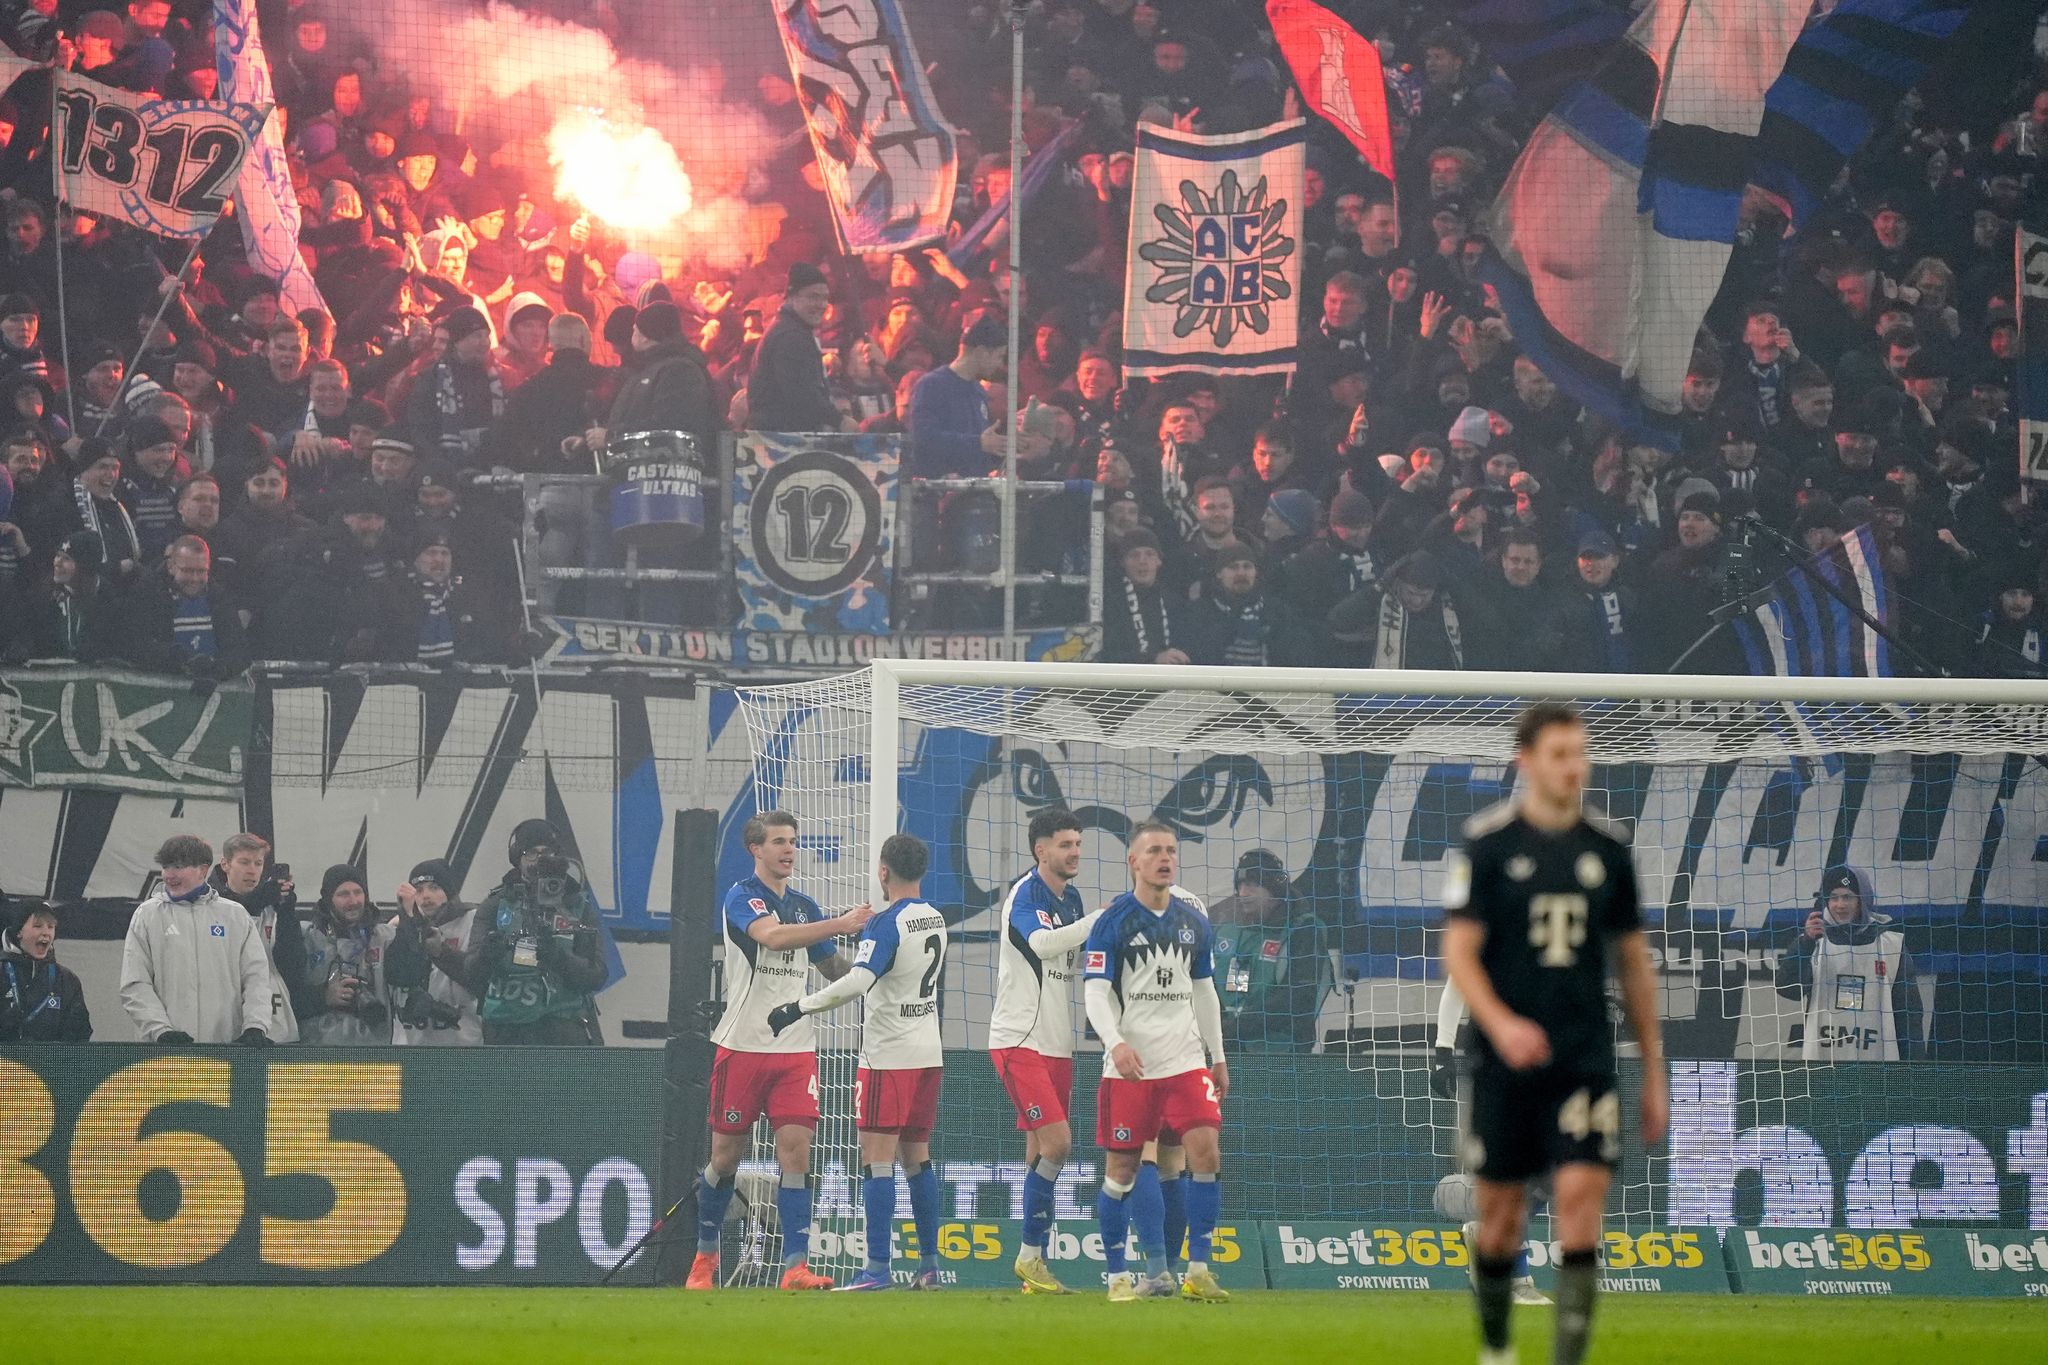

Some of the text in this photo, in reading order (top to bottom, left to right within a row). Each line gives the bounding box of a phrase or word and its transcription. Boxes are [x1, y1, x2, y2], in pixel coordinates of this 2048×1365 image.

[55, 88, 246, 217] 1312
[643, 480, 696, 497] ULTRAS
[775, 483, 852, 564] 12
[575, 622, 1032, 662] SEKTION STADIONVERBOT
[918, 933, 942, 998] 2
[1819, 1025, 1879, 1050] SMF
[1557, 1087, 1621, 1158] 44
[1278, 1225, 1469, 1267] bet365
[1744, 1230, 1932, 1272] bet365
[1336, 1275, 1430, 1290] SPORTWETTEN
[1804, 1280, 1893, 1296] SPORTWETTEN
